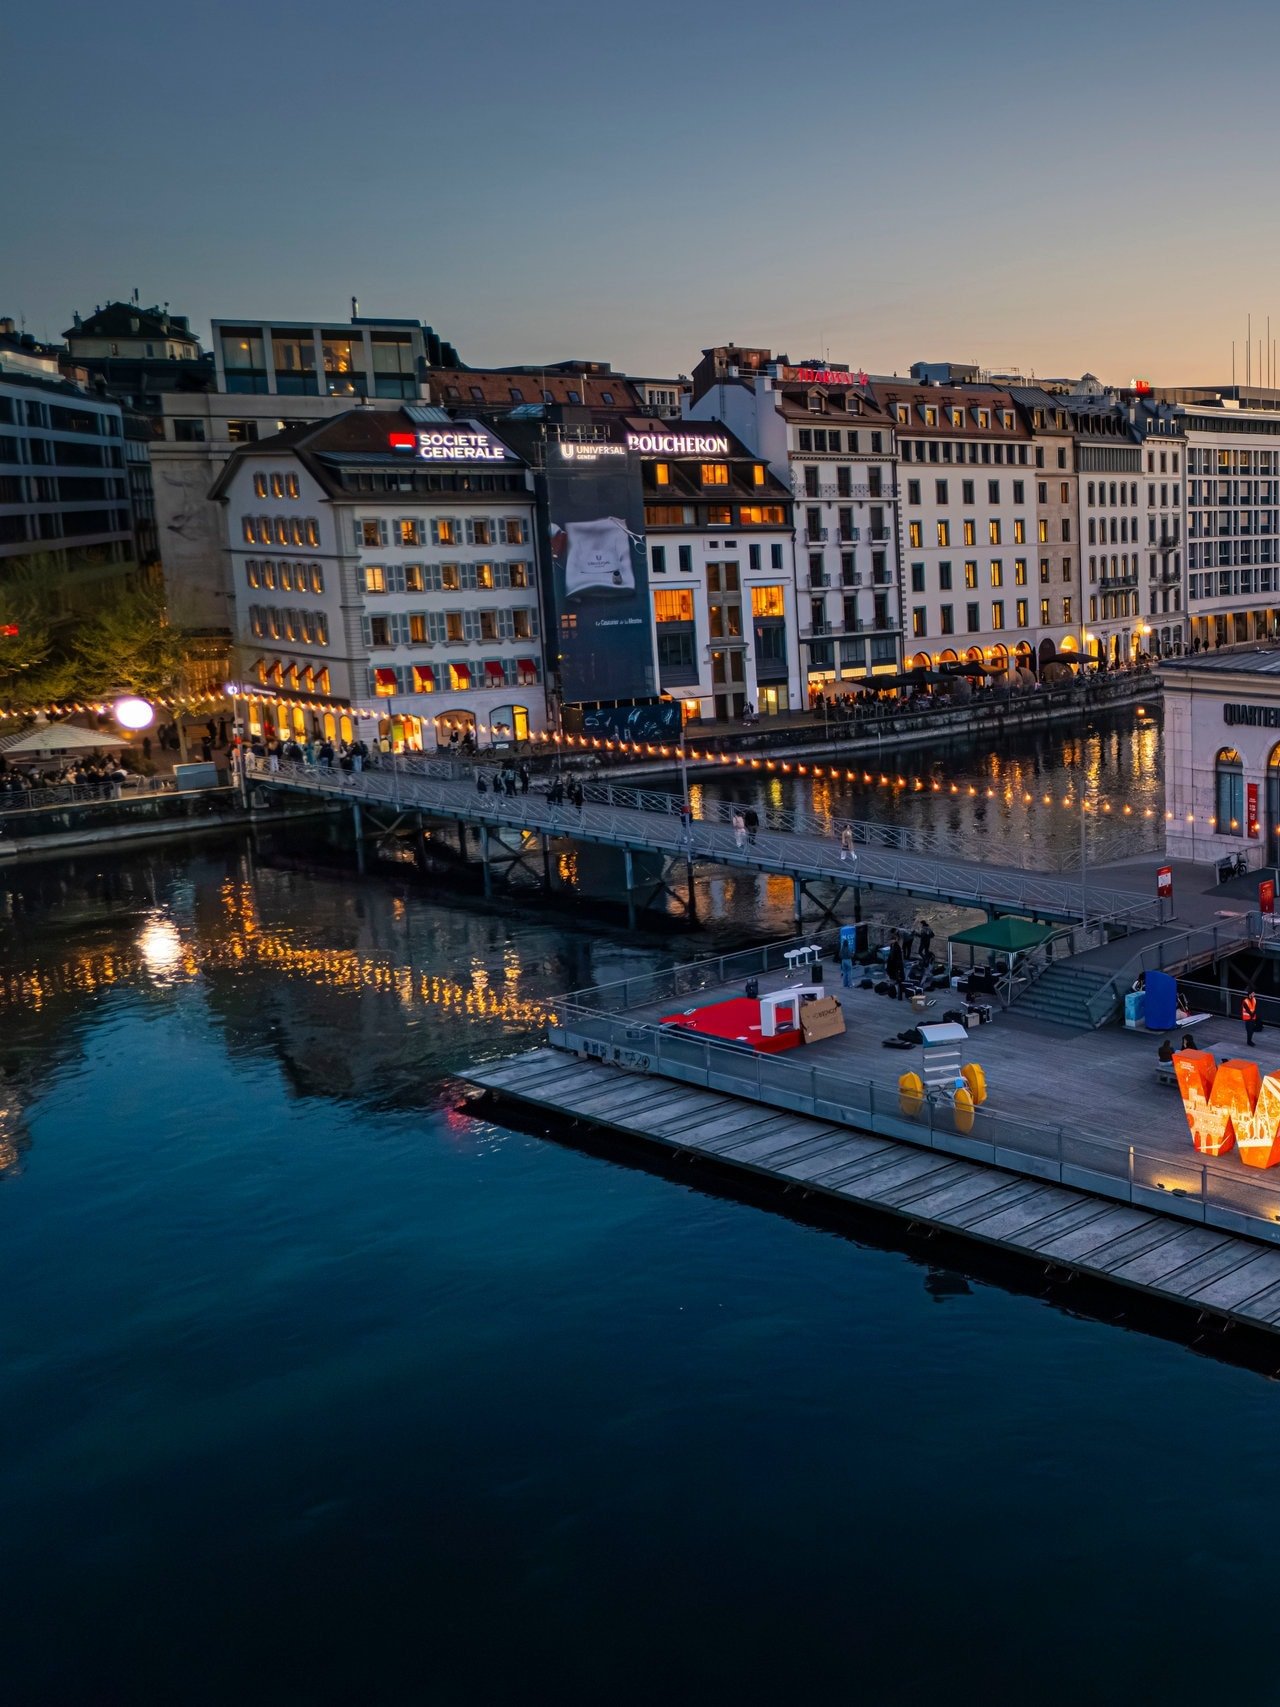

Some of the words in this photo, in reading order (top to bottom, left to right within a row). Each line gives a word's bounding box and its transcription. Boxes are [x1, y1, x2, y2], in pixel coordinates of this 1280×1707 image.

[420, 433, 488, 446] SOCIETE
[628, 434, 728, 452] BOUCHERON
[420, 446, 504, 459] GENERALE
[576, 445, 625, 456] UNIVERSAL
